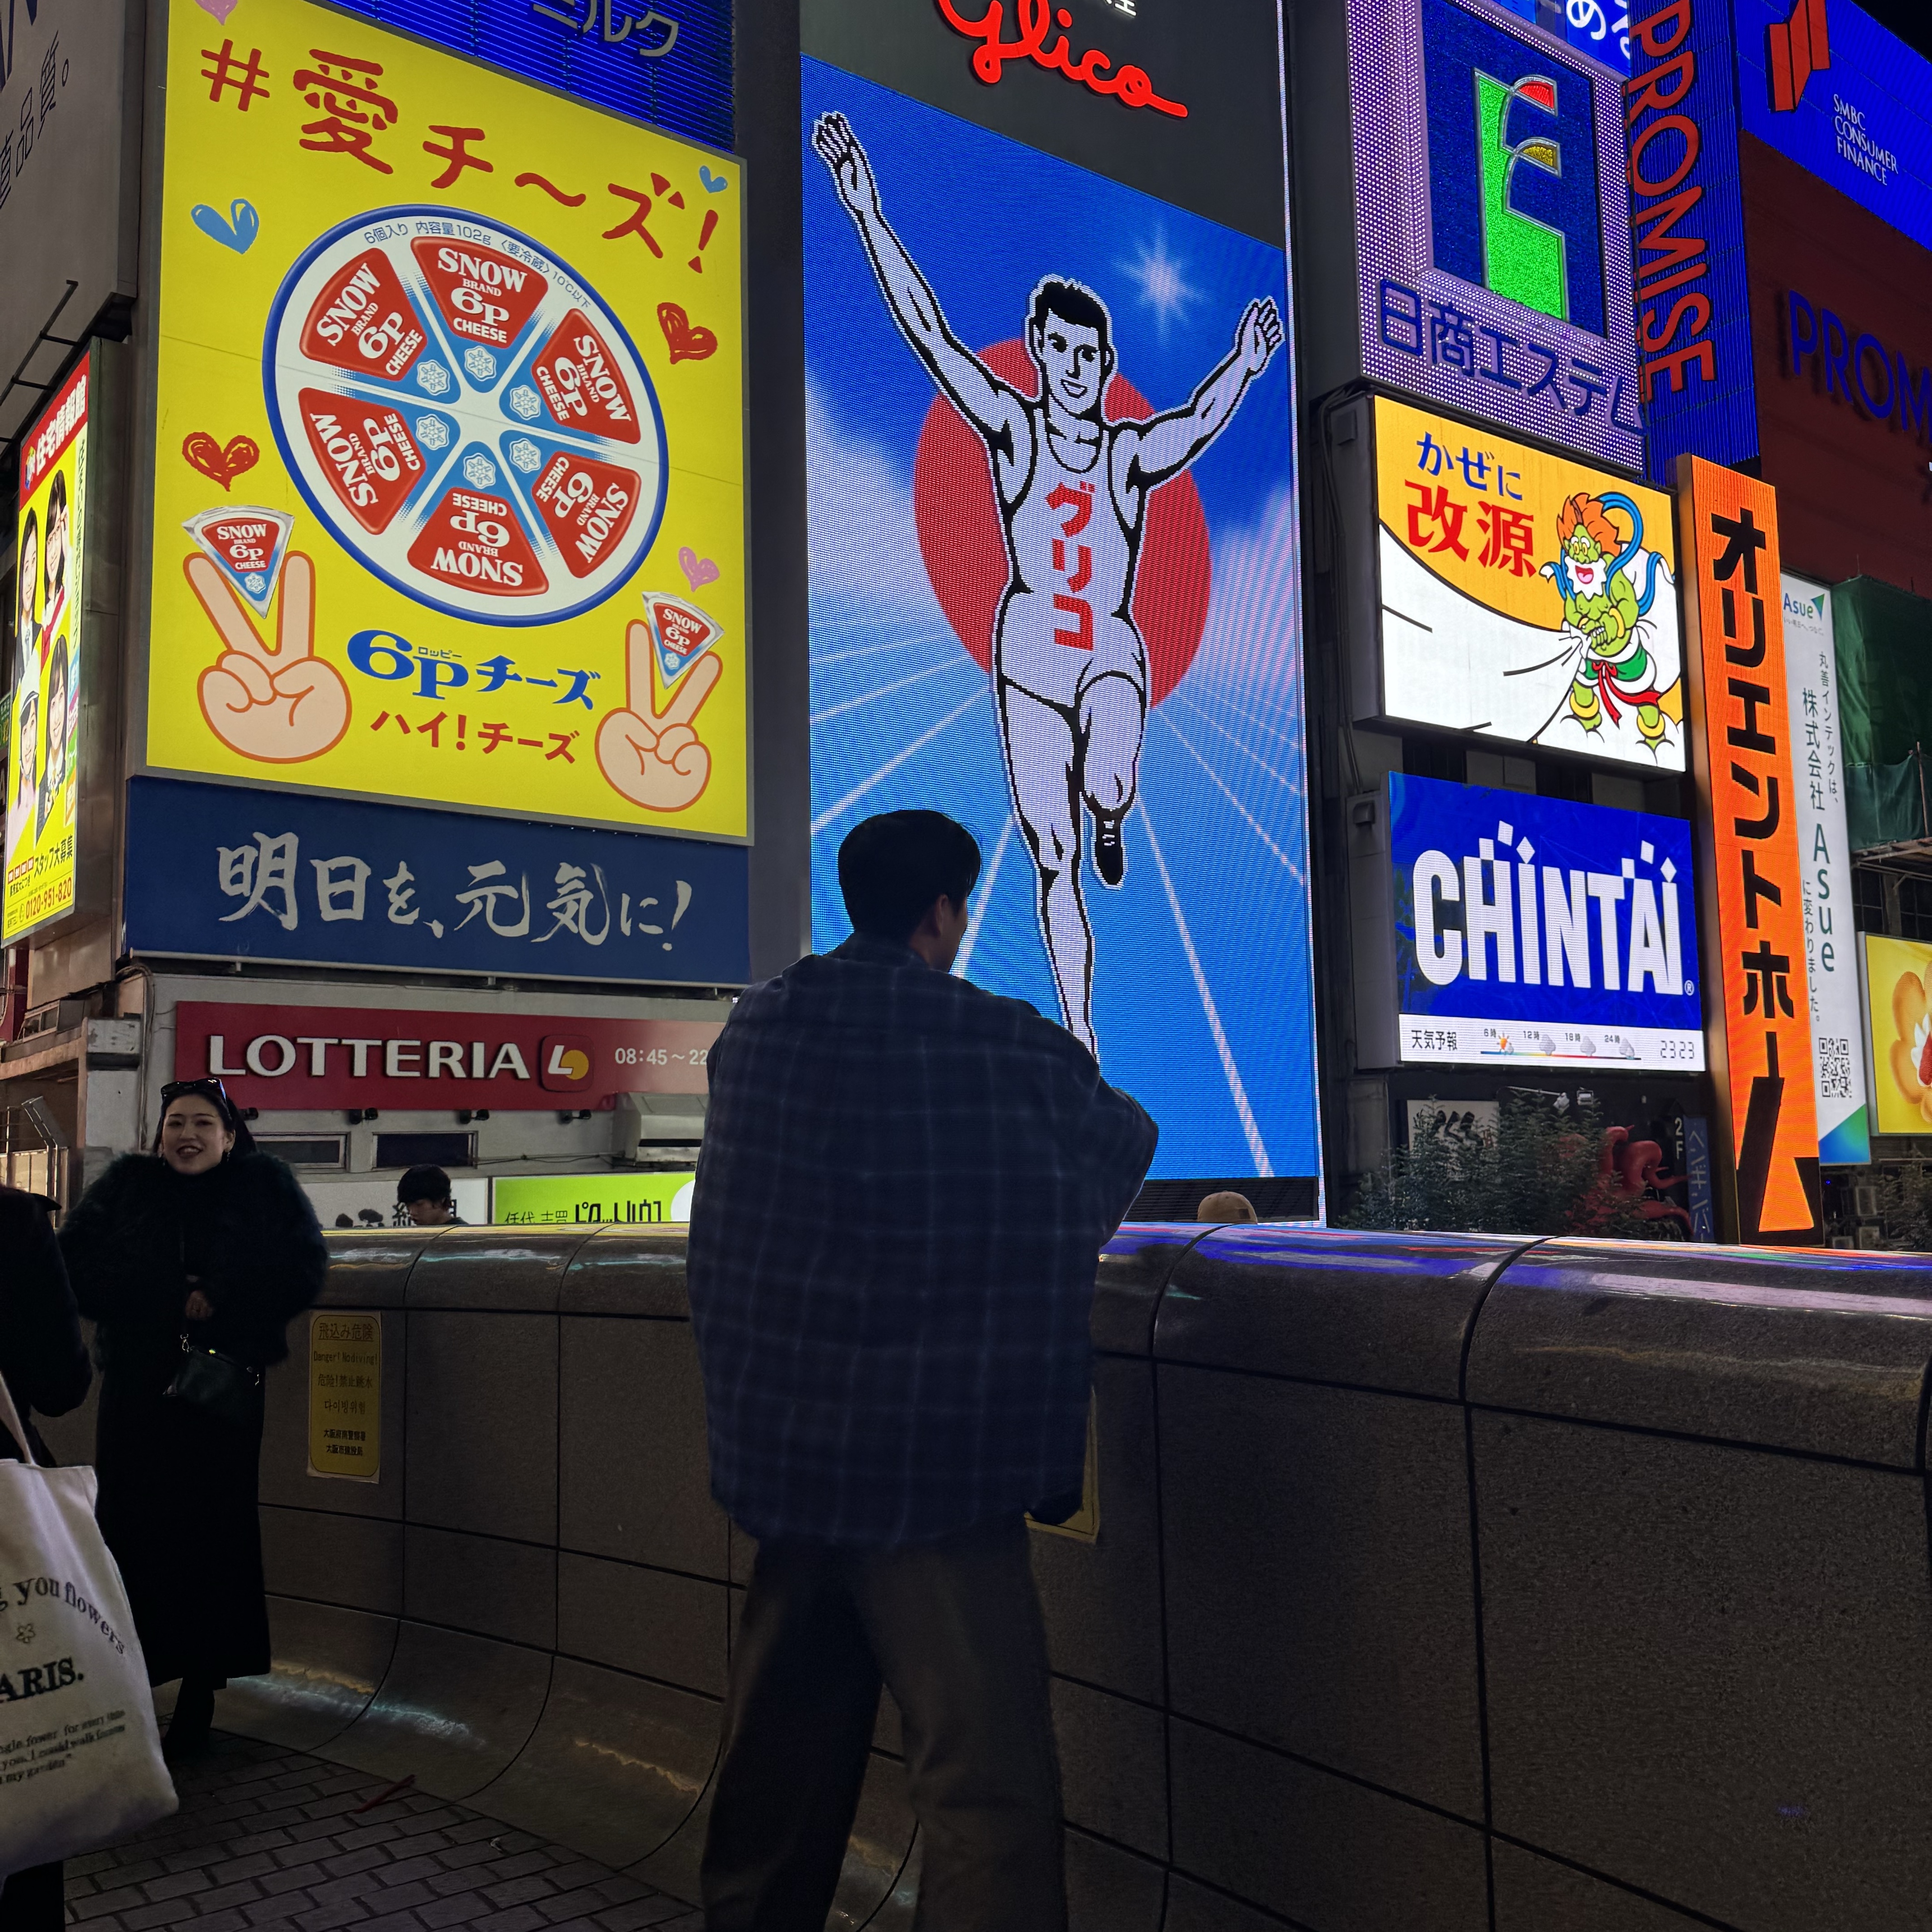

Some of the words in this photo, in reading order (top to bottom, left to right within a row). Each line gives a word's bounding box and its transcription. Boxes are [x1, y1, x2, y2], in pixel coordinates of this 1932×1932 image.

[1833, 93, 1866, 131] SMBC
[1834, 115, 1899, 175] CONSUMER
[1836, 135, 1887, 186] FINANCE
[1627, 0, 1716, 403] PROMISE
[364, 222, 409, 244] 6個入り
[438, 247, 528, 292] SNOW
[462, 278, 502, 297] BRAND
[316, 263, 381, 346] SNOW
[350, 302, 379, 336] BRAND
[451, 286, 510, 327] 6P
[359, 312, 405, 359] 6P
[453, 317, 507, 343] CHEESE
[385, 329, 423, 376] CHEESE
[536, 366, 570, 421] CHEESE
[554, 357, 588, 417] 6P
[573, 335, 632, 422] SNOW
[576, 363, 600, 403] BRAND
[309, 413, 379, 507] SNOW
[349, 432, 375, 476] BRAND
[363, 418, 400, 481] 6P
[383, 413, 421, 471] CHEESE
[536, 456, 570, 502] CHEESE
[1416, 431, 1524, 501] かぜに
[452, 492, 507, 516] CHEESE
[553, 472, 593, 518] 6P
[576, 492, 600, 526] BRAND
[216, 524, 267, 540] SNOW
[450, 510, 510, 547] 6P
[575, 482, 629, 564] SNOW
[1404, 479, 1536, 578] 改源
[229, 544, 264, 561] 6P
[235, 560, 266, 570] CHEESE
[430, 547, 523, 587] SNOW
[458, 541, 499, 557] BRAND
[1045, 480, 1095, 651] グリコ
[663, 608, 703, 634] SNOW
[1783, 593, 1814, 619] Asue
[418, 646, 462, 659] ロッピー
[663, 639, 688, 655] CHEESE
[665, 626, 690, 647] 6P
[347, 629, 601, 710] 6Pチーズ
[370, 710, 580, 764] ハイ!チーズ
[1803, 687, 1826, 811] 株式会社
[216, 831, 693, 951] 明日を、元気に!
[1813, 823, 1835, 972] Asue
[1803, 879, 1820, 1022] に変わりました。
[209, 1035, 530, 1079] LOTTERIA
[1411, 1029, 1458, 1051] 天気予報
[1674, 1117, 1684, 1160] 2F
[318, 1323, 374, 1340] 飛込み危険
[313, 1351, 340, 1362] Danger!
[324, 1398, 366, 1415] 다이빙위험
[13, 1577, 60, 1606] you
[64, 1581, 124, 1655] flowers
[64, 1724, 79, 1736] for
